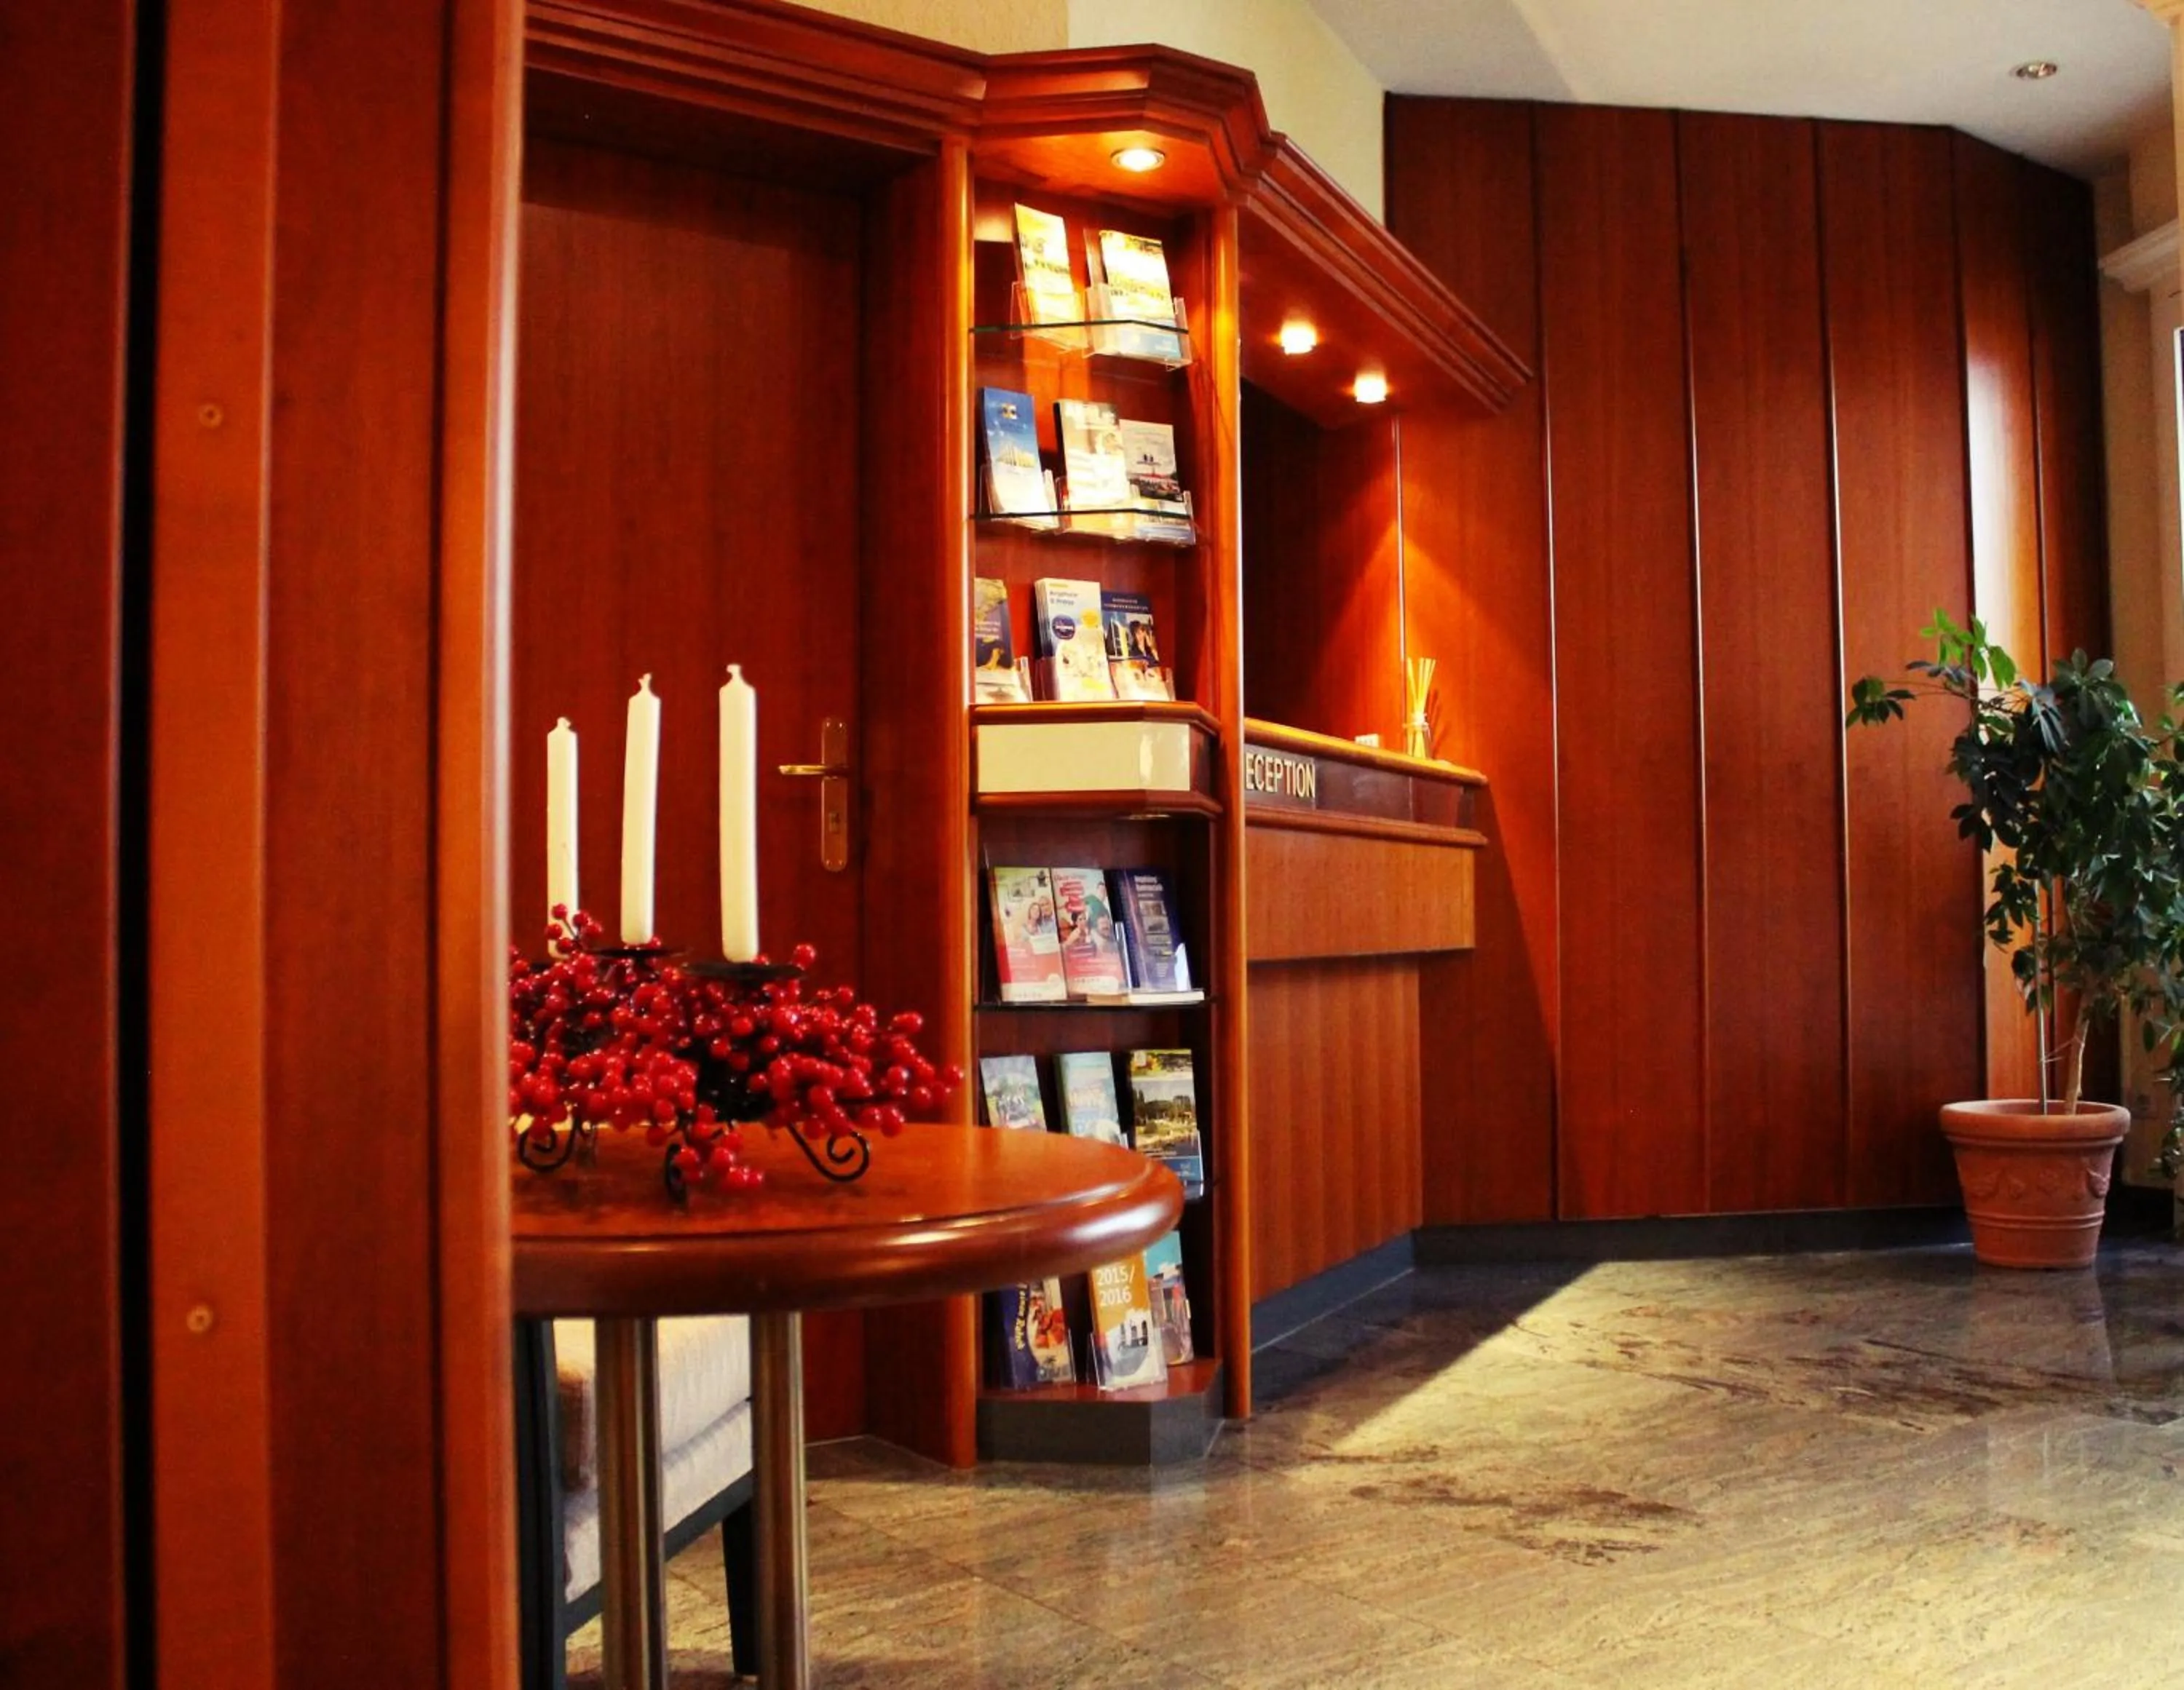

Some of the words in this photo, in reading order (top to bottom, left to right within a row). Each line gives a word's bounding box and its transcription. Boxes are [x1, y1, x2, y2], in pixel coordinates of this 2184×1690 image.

[1246, 752, 1315, 798] ECEPTION
[1096, 1264, 1135, 1286] 2015/
[1099, 1285, 1132, 1306] 2016
